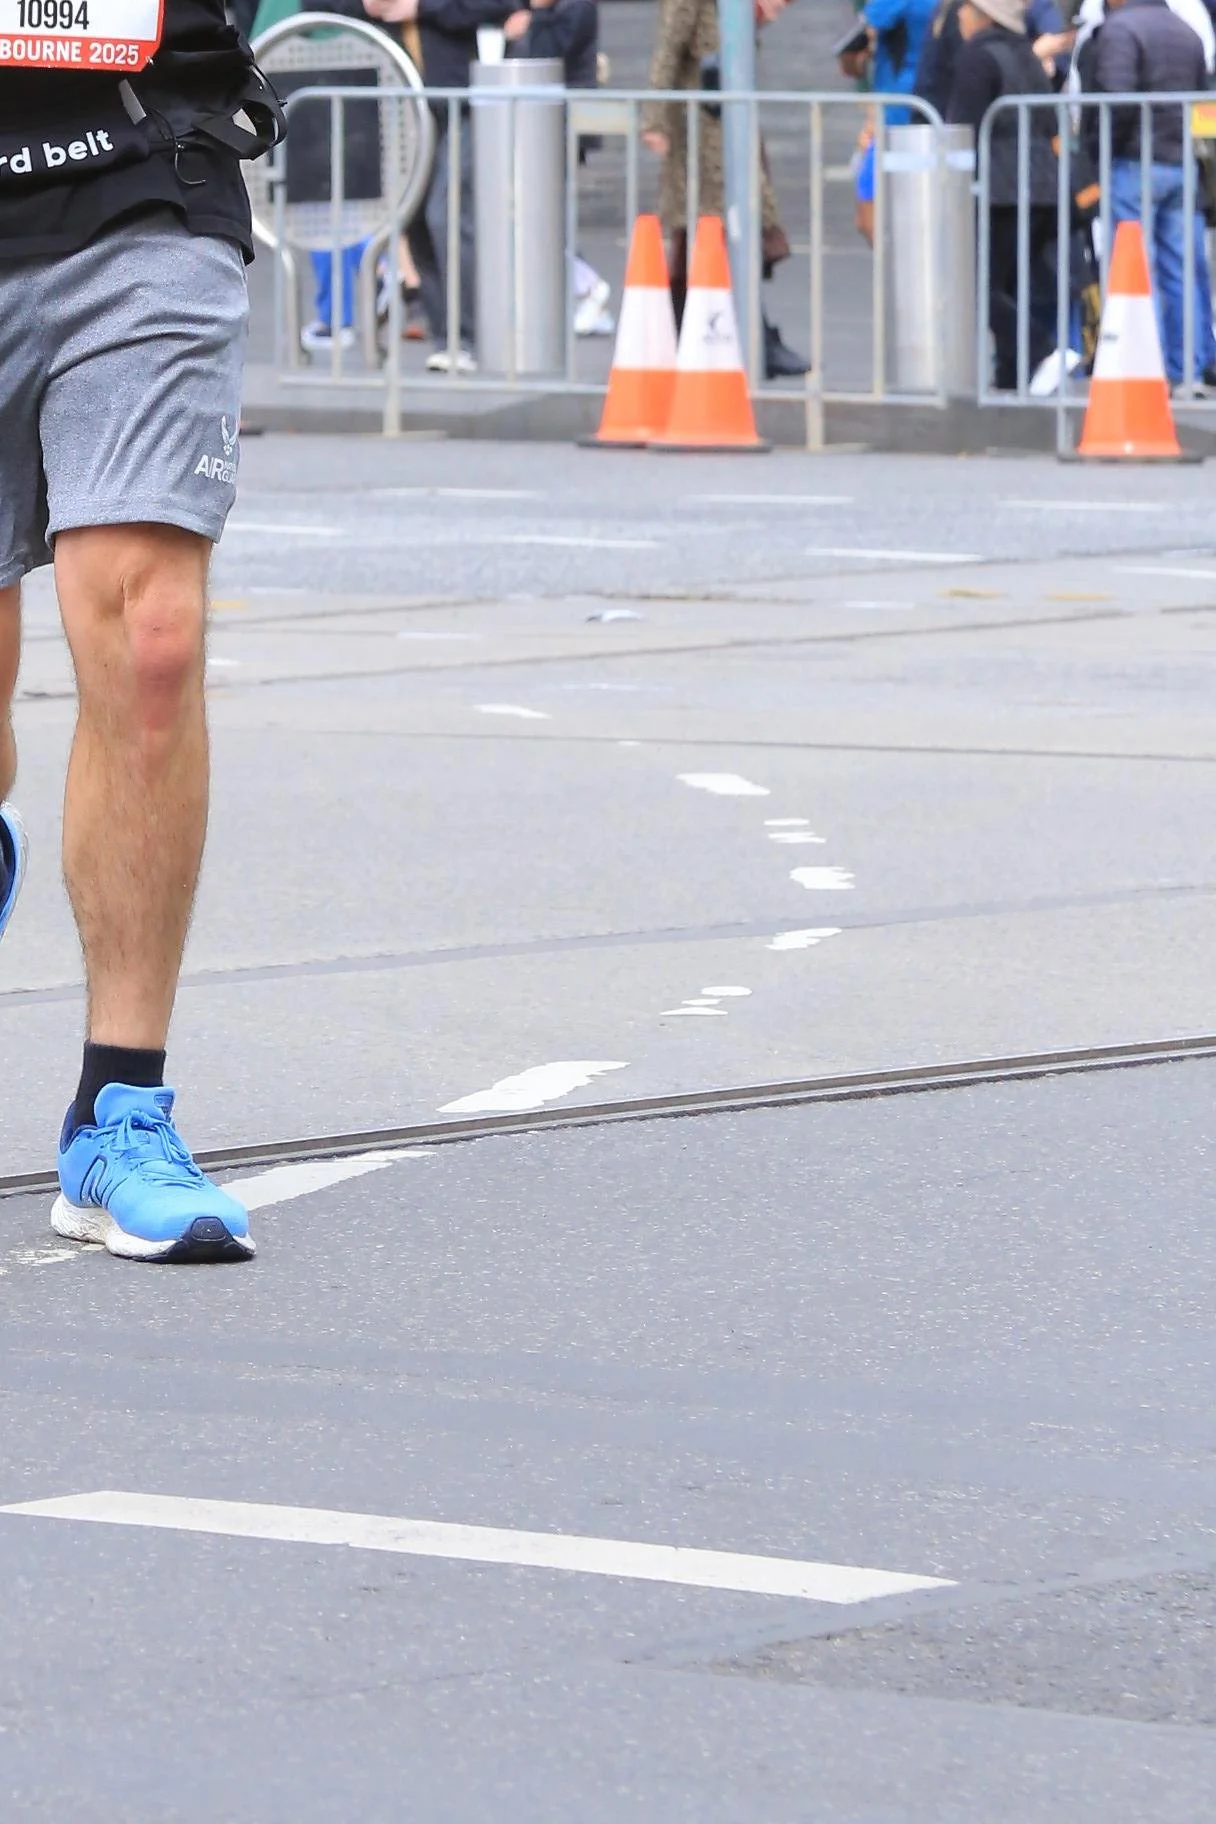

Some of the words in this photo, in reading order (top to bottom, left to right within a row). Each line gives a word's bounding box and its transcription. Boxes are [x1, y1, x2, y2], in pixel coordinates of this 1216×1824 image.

[89, 43, 139, 65] 2025
[42, 129, 114, 168] belt
[194, 454, 224, 481] AIR
